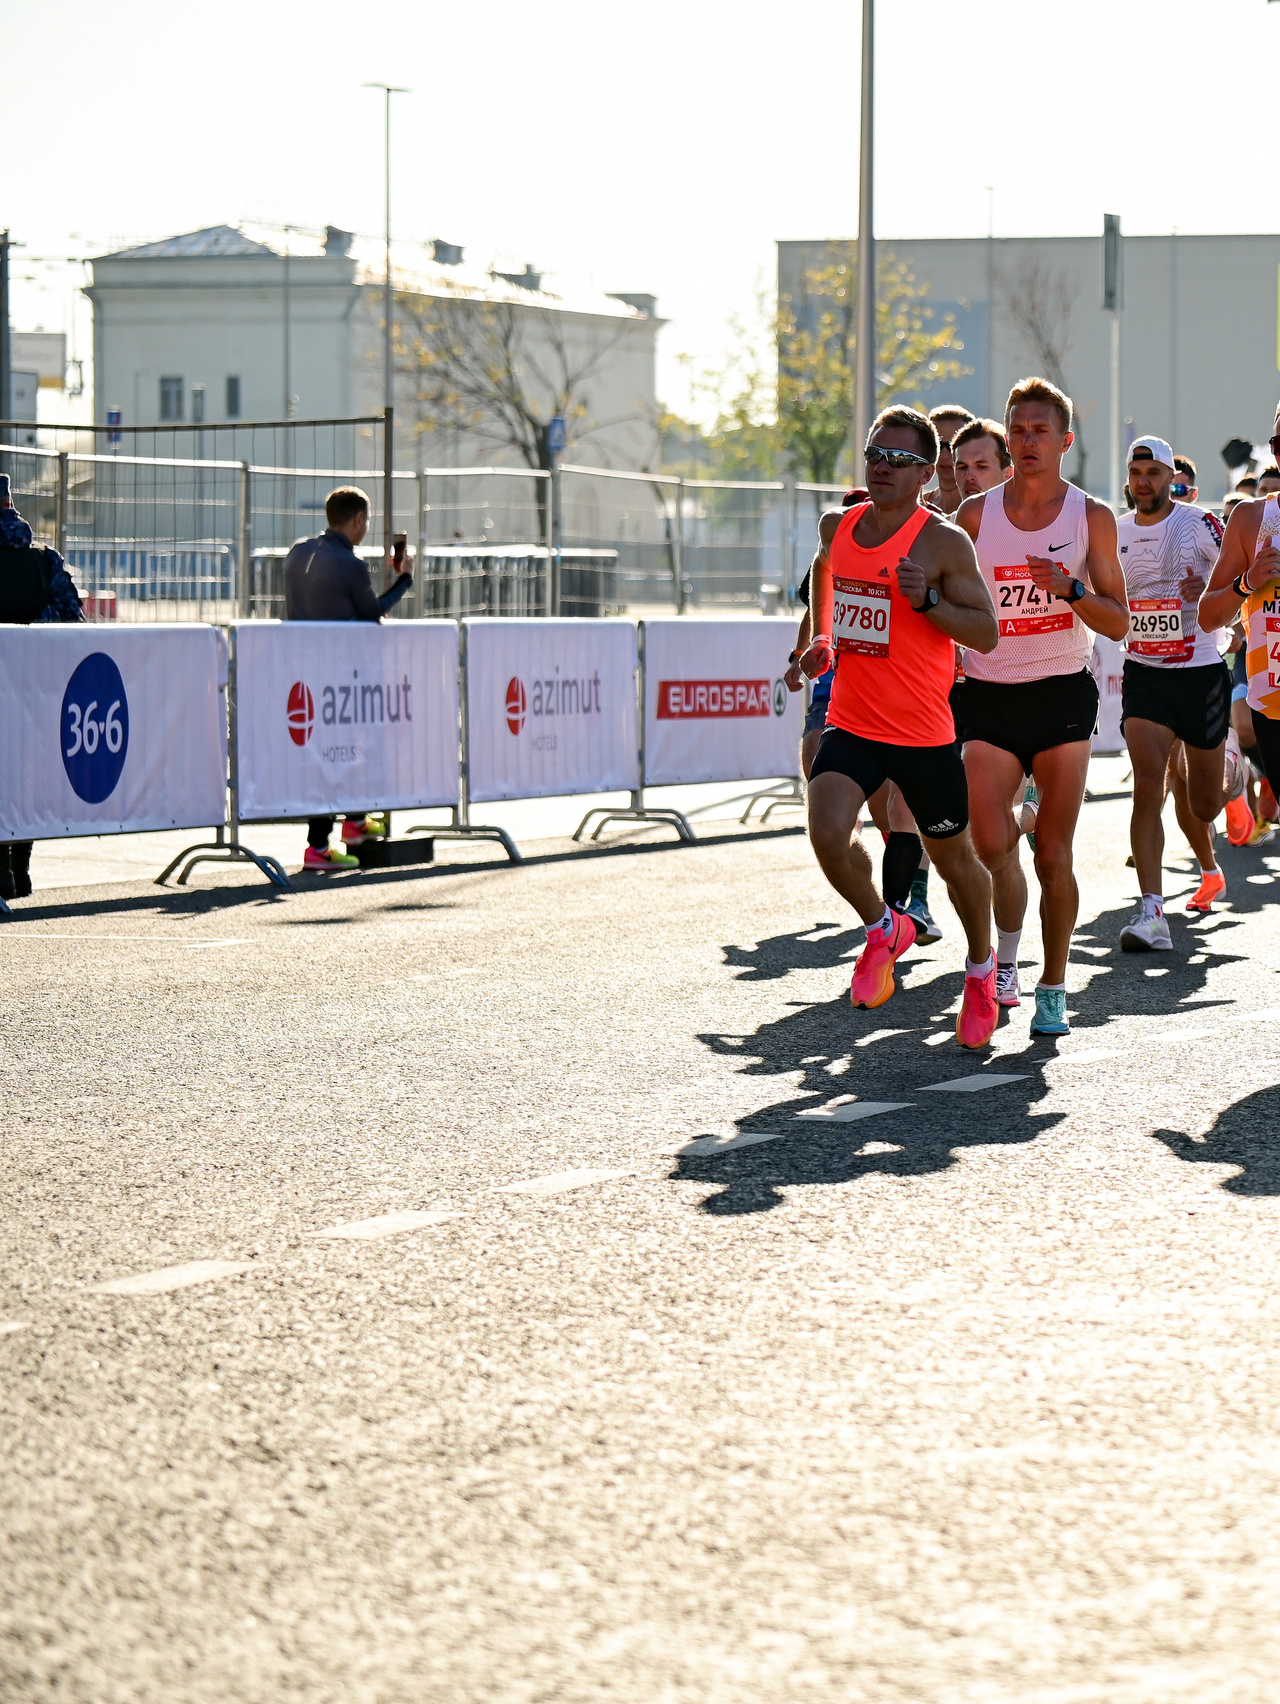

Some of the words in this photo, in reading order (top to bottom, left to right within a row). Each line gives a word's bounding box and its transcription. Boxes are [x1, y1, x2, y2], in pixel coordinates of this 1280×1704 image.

[875, 589, 886, 597] КМ
[999, 584, 1065, 608] 2741
[834, 600, 887, 632] 39780
[1021, 605, 1049, 615] АНДРЕЙ
[1131, 615, 1180, 632] 26950
[322, 669, 412, 725] azimut
[532, 664, 601, 717] azimut
[669, 684, 770, 713] EUROSPAR
[321, 745, 357, 763] HOTELS
[927, 822, 959, 833] adidas
